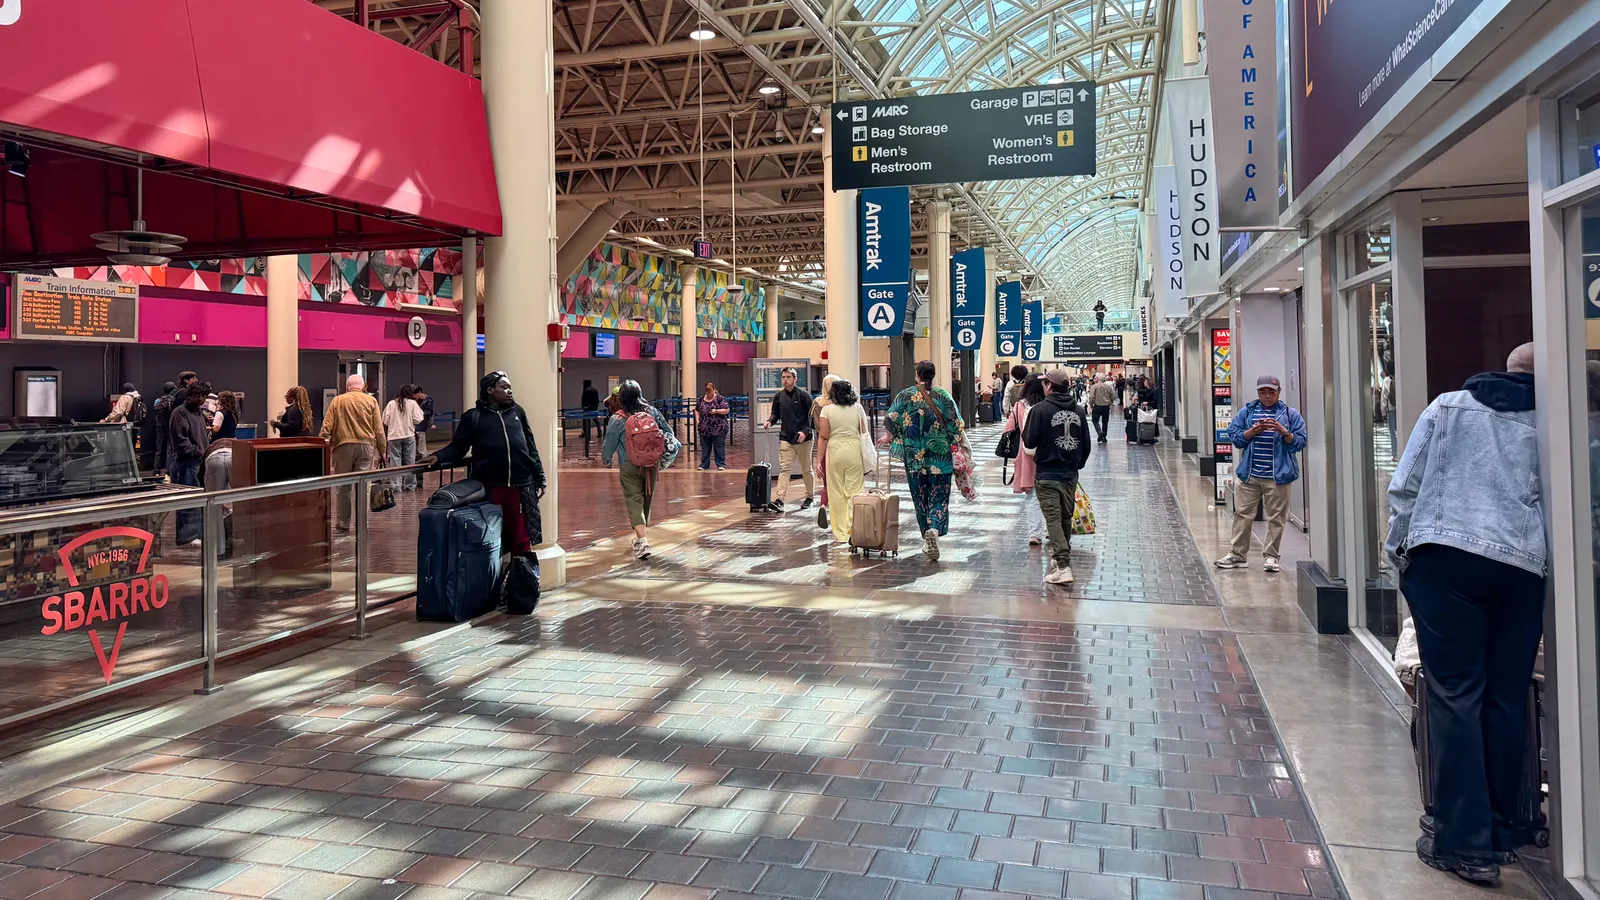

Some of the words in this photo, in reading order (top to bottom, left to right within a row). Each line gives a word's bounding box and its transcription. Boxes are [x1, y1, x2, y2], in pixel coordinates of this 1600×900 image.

[1358, 82, 1372, 108] Learn
[1372, 67, 1386, 92] more
[1385, 55, 1392, 77] at
[872, 104, 909, 118] MARC
[970, 97, 1018, 111] Garage
[1024, 113, 1053, 126] VRE
[1241, 44, 1257, 202] AMERICA
[871, 126, 895, 140] Bag
[898, 123, 949, 138] Storage
[992, 134, 1053, 149] Women's
[871, 146, 908, 158] Men's
[988, 151, 1053, 166] Restroom
[871, 161, 932, 174] Restroom
[1189, 118, 1211, 262] HUDSON
[865, 201, 882, 271] Amtrak
[699, 243, 710, 257] EXIT
[46, 283, 67, 292] Train
[69, 284, 116, 296] Information
[955, 262, 968, 308] Amtrak
[868, 289, 894, 299] Gate
[872, 305, 891, 324] A
[998, 291, 1008, 326] Amtrak
[957, 319, 976, 327] Gate
[1024, 309, 1032, 336] Amtrak
[1141, 306, 1149, 346] STARBUCKS
[414, 323, 421, 339] B
[962, 331, 972, 343] B
[1002, 342, 1011, 352] C
[1027, 348, 1034, 358] D
[87, 549, 129, 569] NYC.1956
[40, 574, 169, 635] SBARRO
